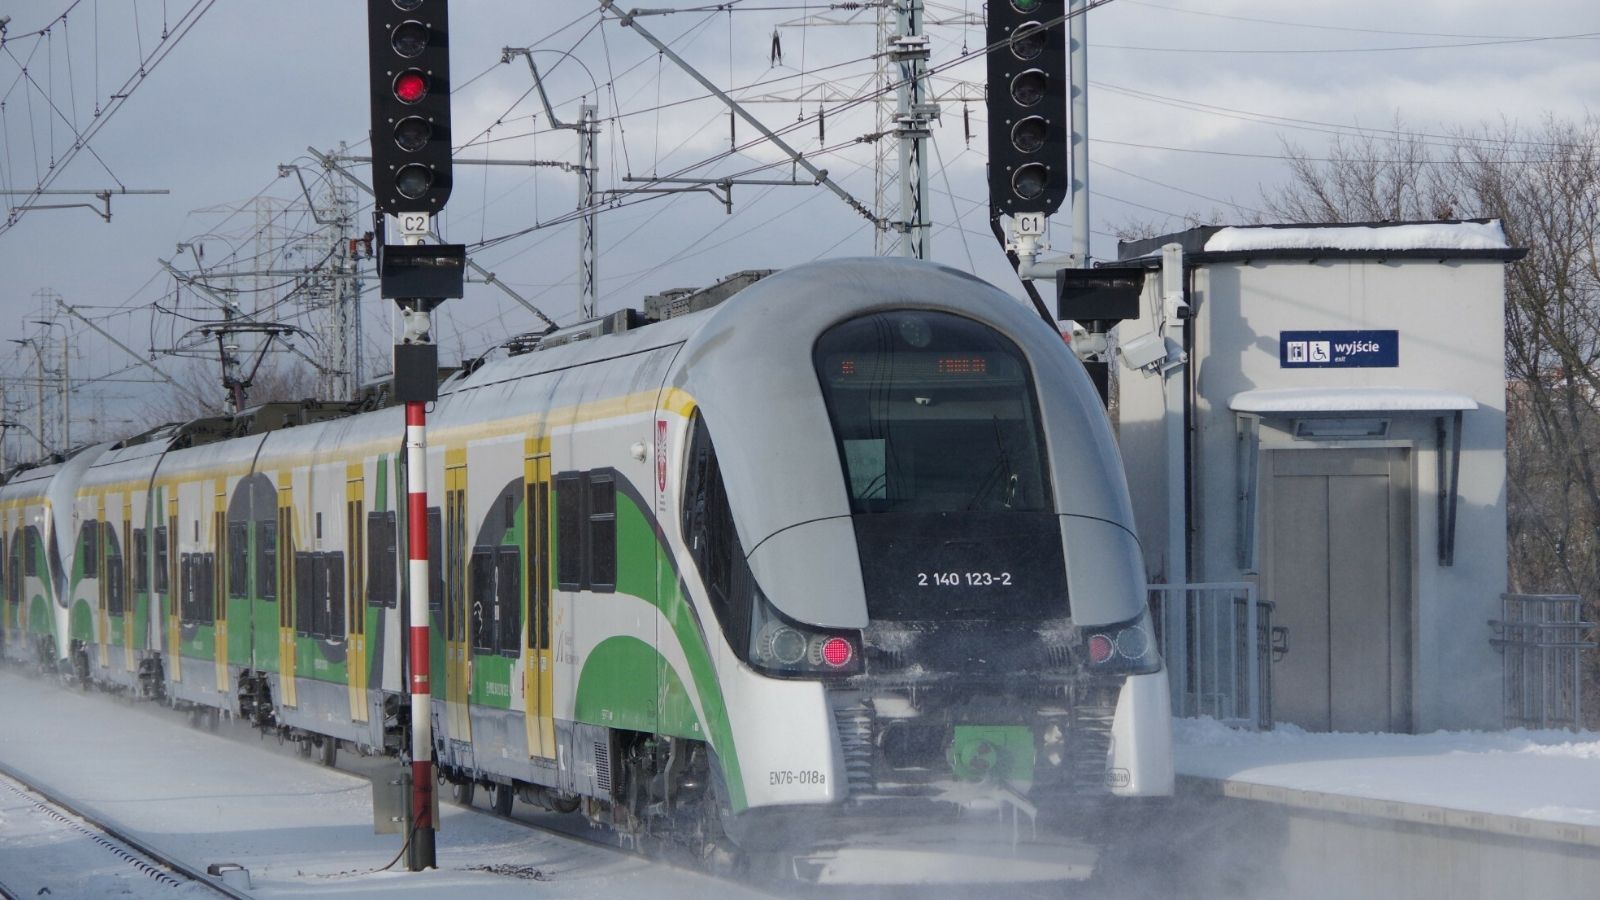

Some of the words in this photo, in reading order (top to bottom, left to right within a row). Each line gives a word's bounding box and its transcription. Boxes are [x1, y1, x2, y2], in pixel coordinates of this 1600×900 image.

[405, 216, 425, 231] C2
[1021, 217, 1038, 231] C1
[1334, 340, 1380, 355] wyjście
[917, 572, 928, 586] 2
[933, 572, 960, 586] 140
[965, 572, 1012, 586] 123-2
[769, 770, 826, 785] EN76-018a
